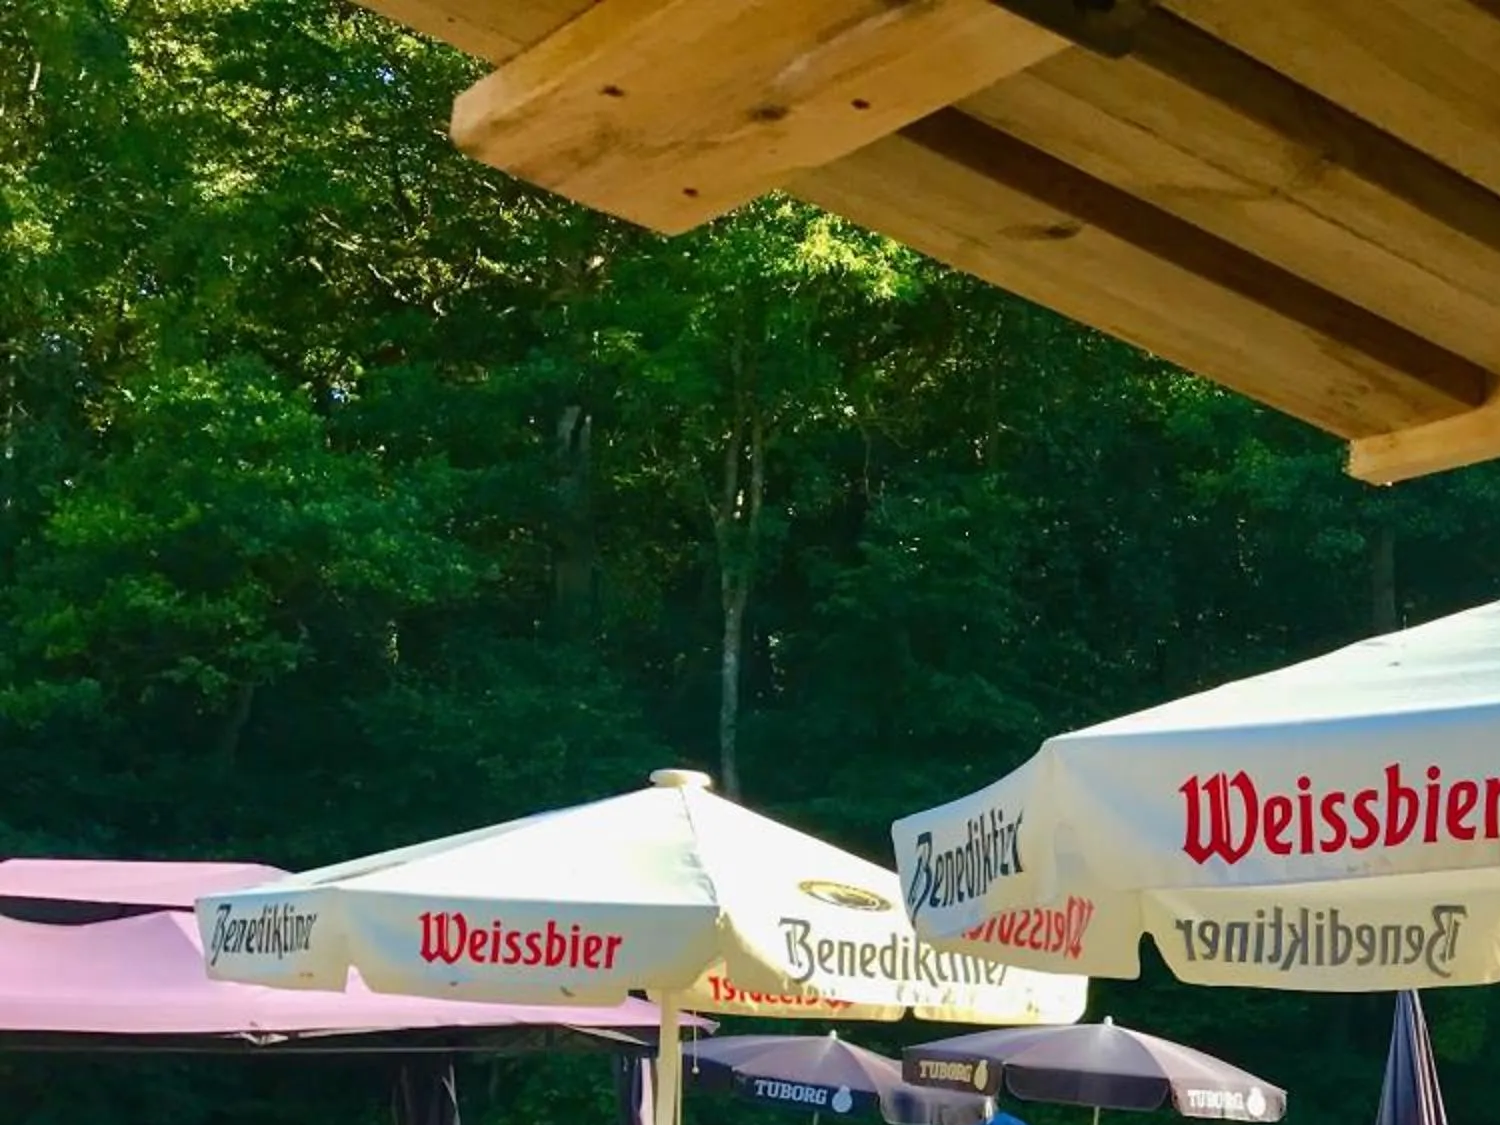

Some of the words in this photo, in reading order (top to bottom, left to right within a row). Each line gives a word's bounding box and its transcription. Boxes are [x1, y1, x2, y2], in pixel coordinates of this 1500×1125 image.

[417, 911, 623, 970] Weissbier
[919, 1060, 973, 1083] TUBORG
[755, 1079, 828, 1105] TUBORG
